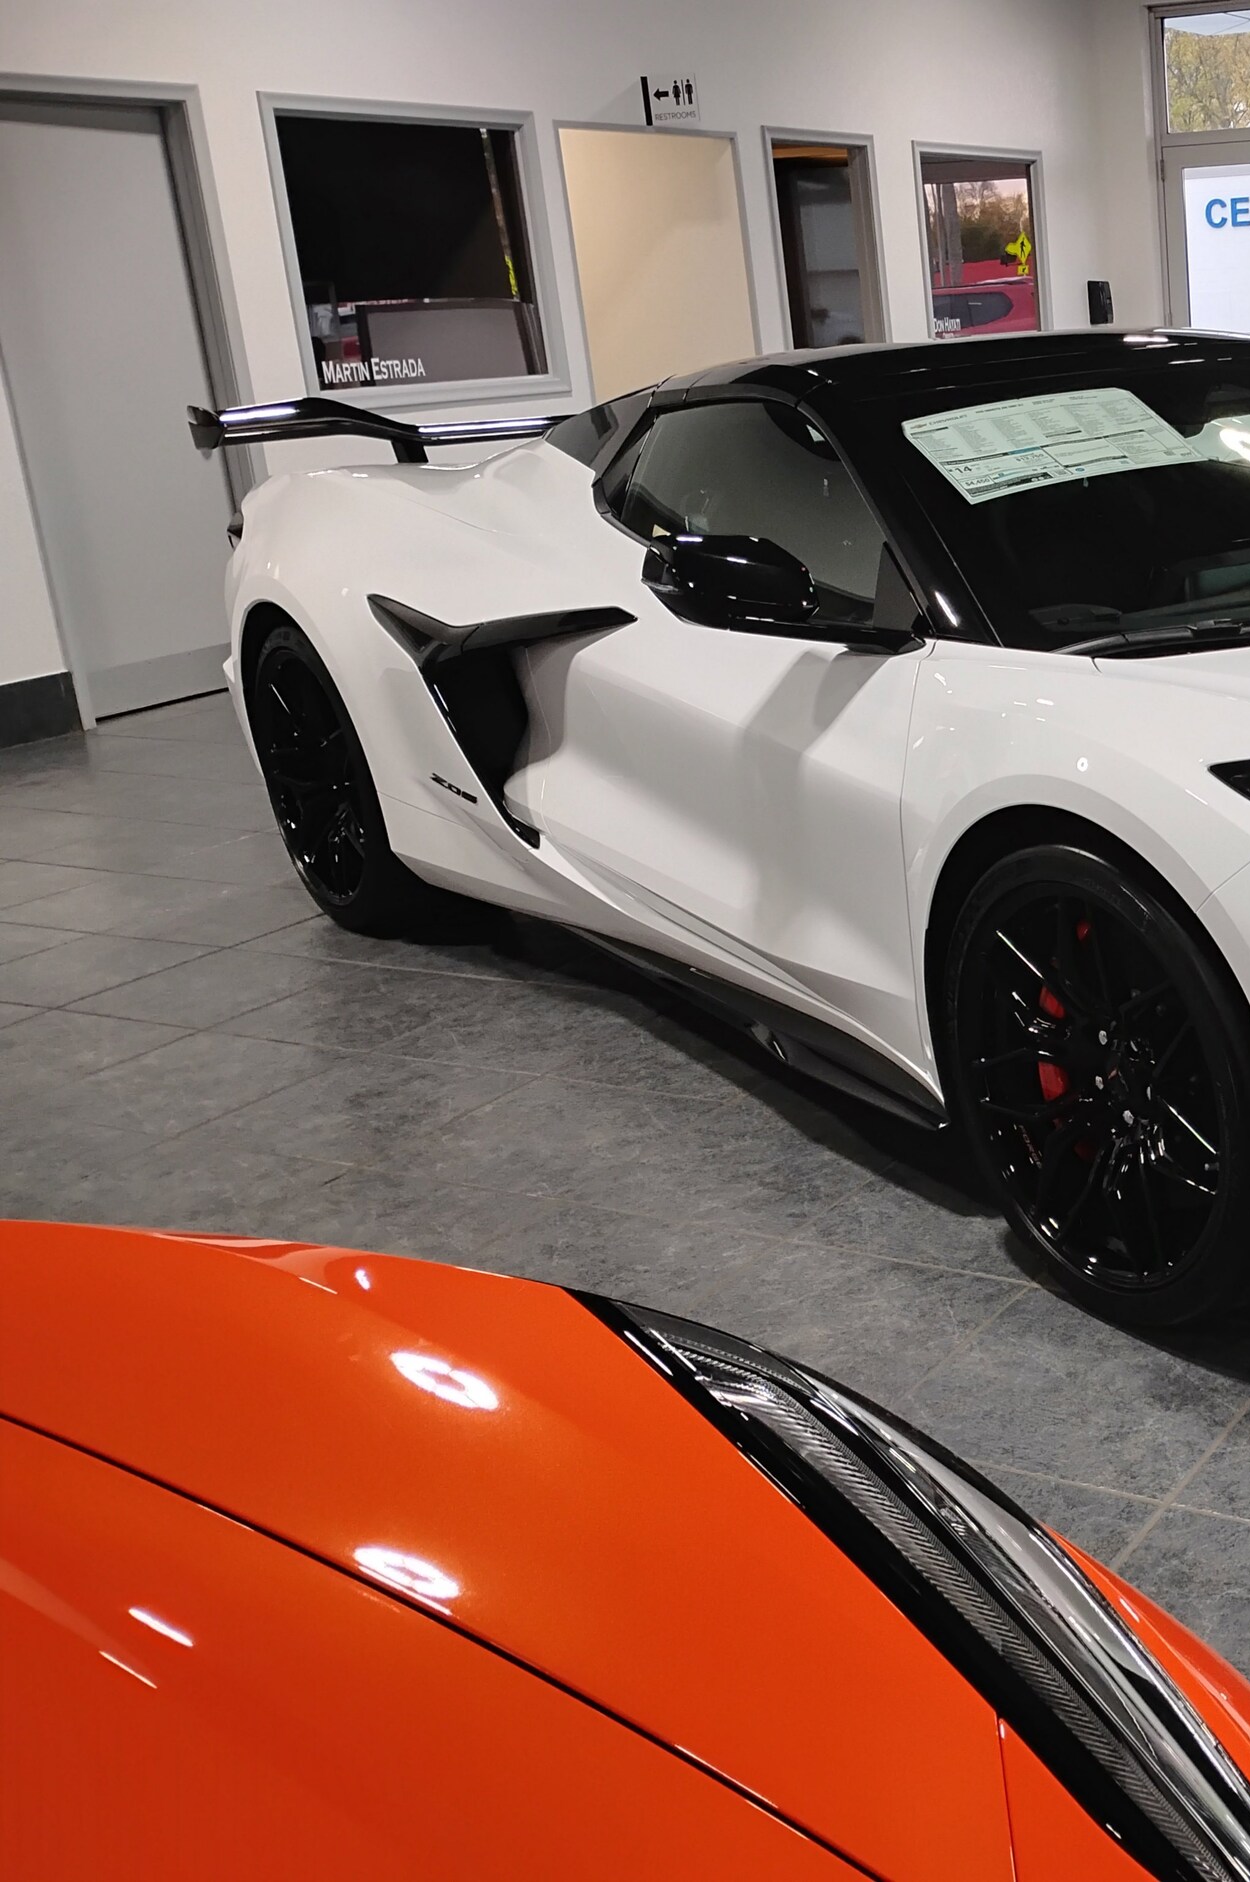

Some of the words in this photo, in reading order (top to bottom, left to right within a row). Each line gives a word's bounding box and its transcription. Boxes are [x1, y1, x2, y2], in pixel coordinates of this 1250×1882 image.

[654, 110, 697, 121] RESTROOMS
[321, 360, 371, 384] MARTIN
[370, 357, 426, 380] ESTRADA
